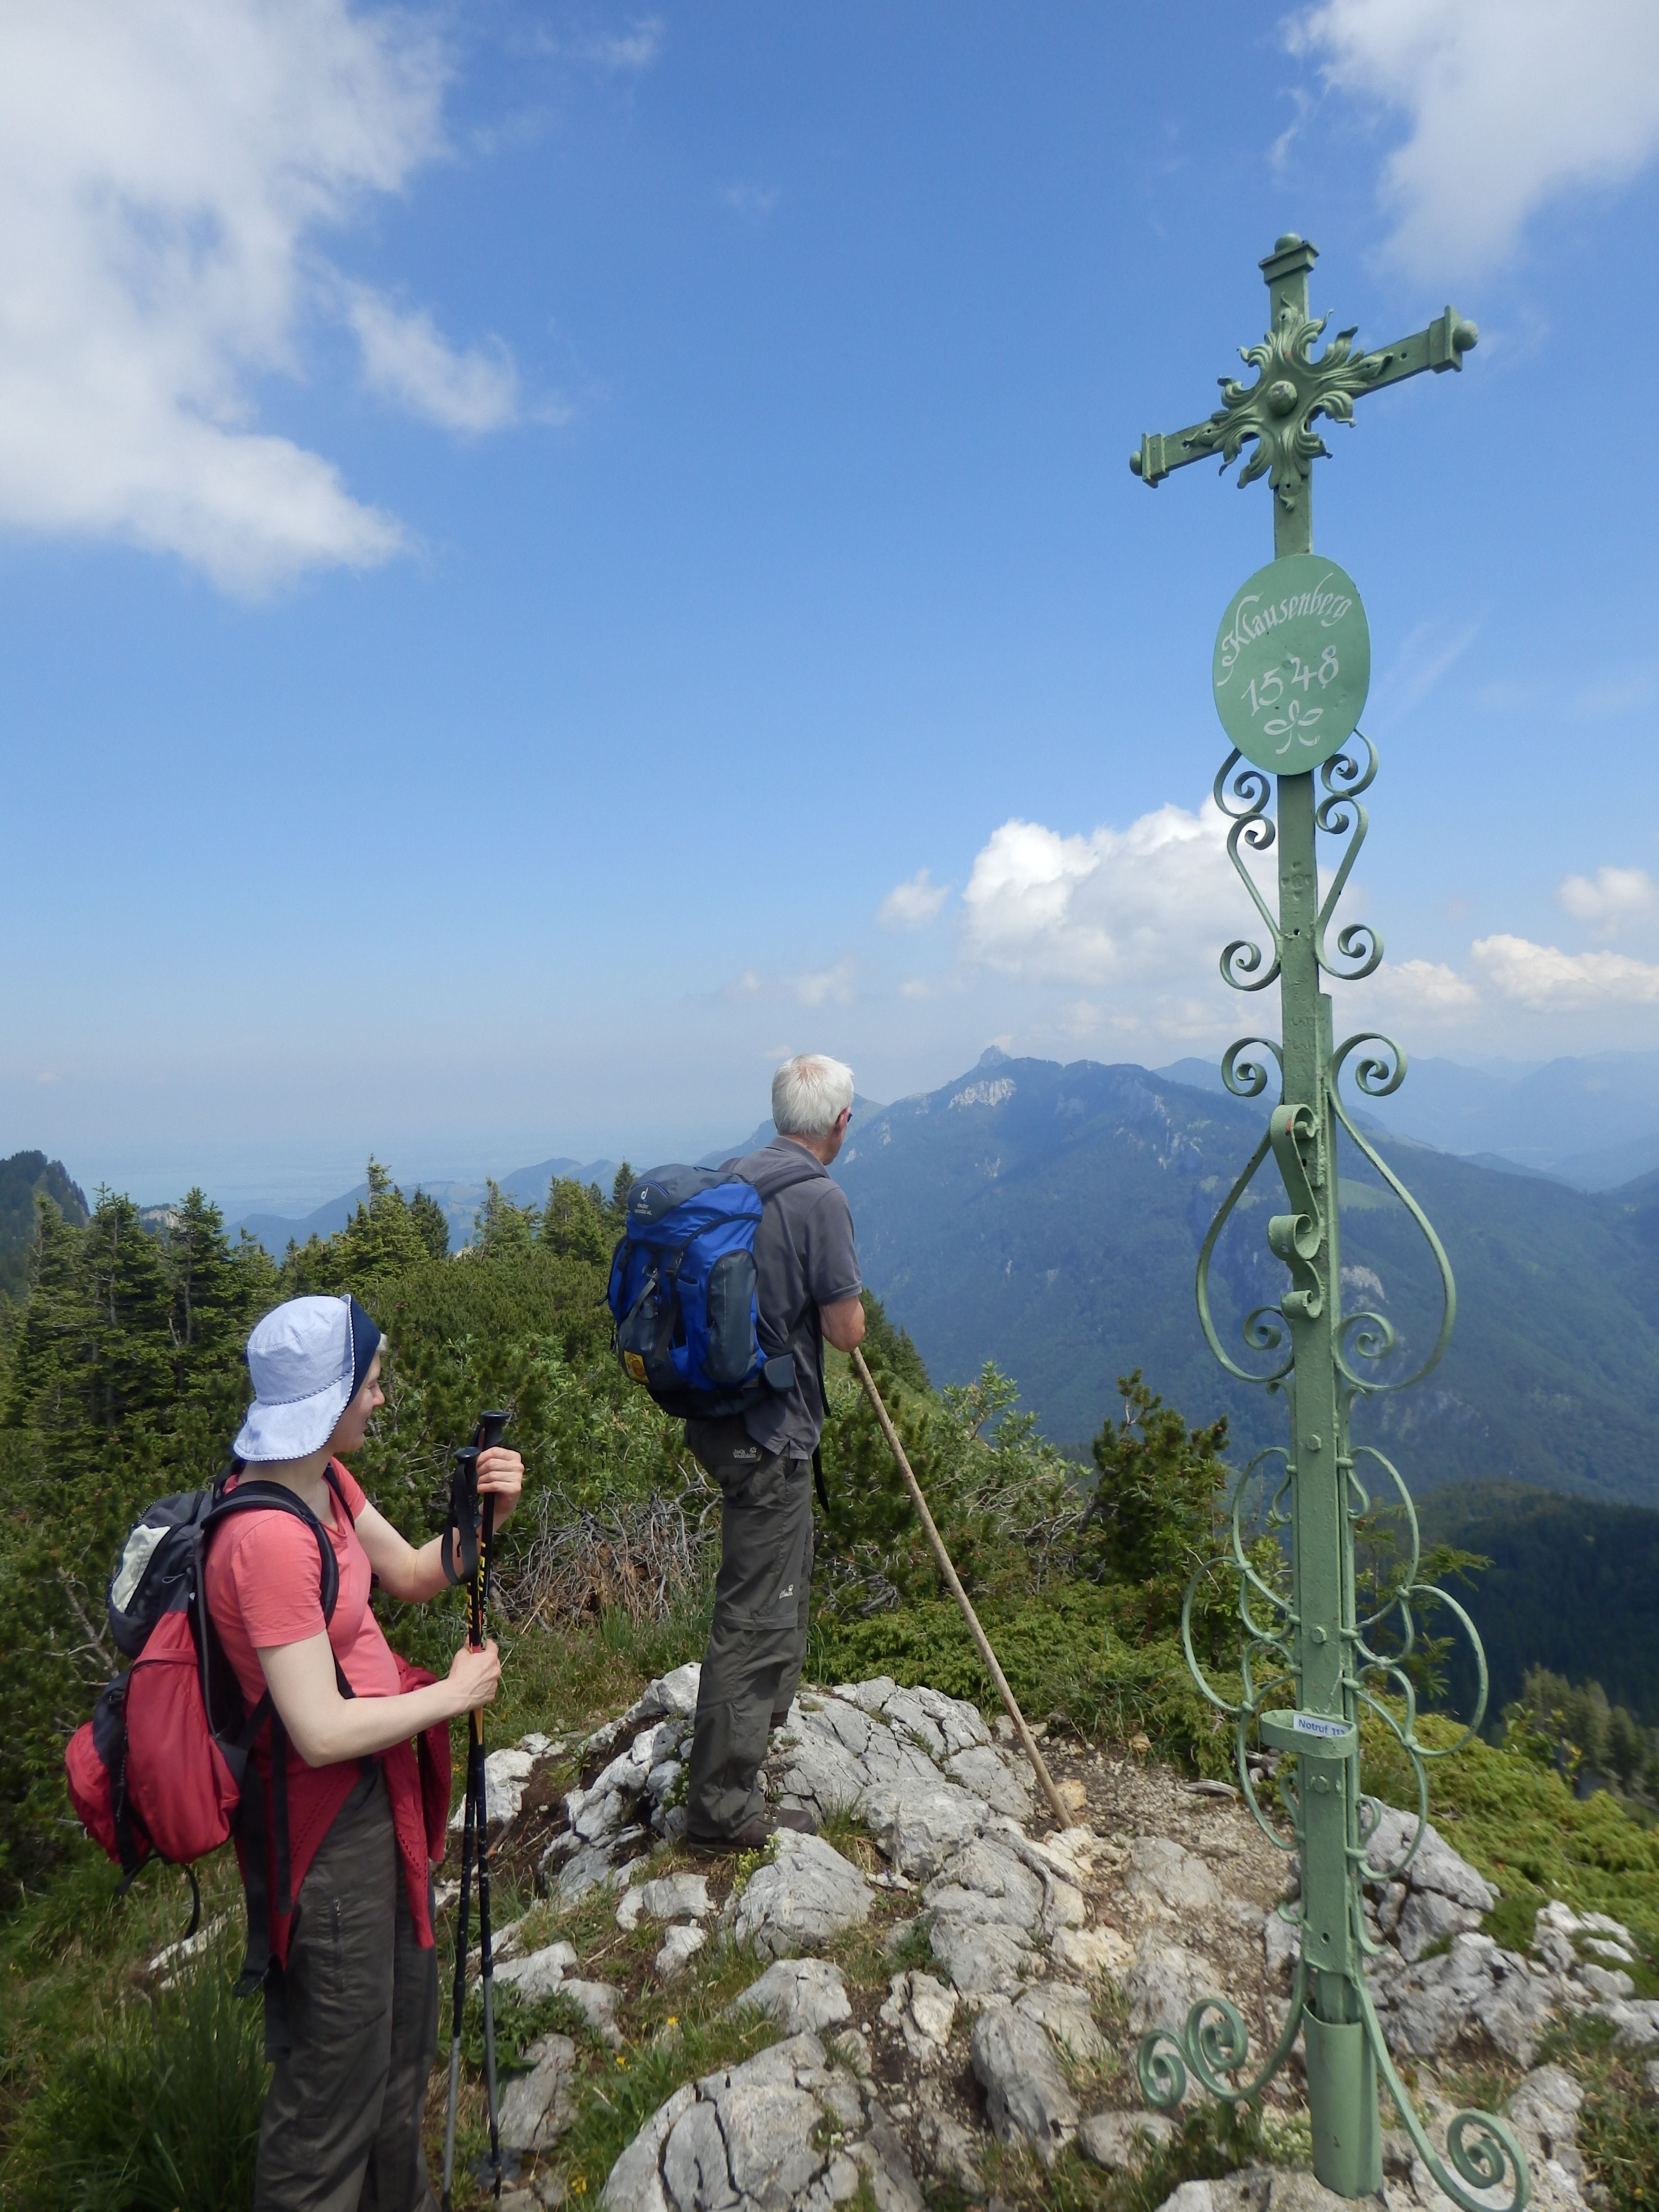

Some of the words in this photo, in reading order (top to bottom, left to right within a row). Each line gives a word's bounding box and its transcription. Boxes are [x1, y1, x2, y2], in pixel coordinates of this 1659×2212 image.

[1216, 572, 1352, 686] Klausenberg
[1241, 645, 1339, 717] 1548
[1298, 1719, 1328, 1734] Notruf
